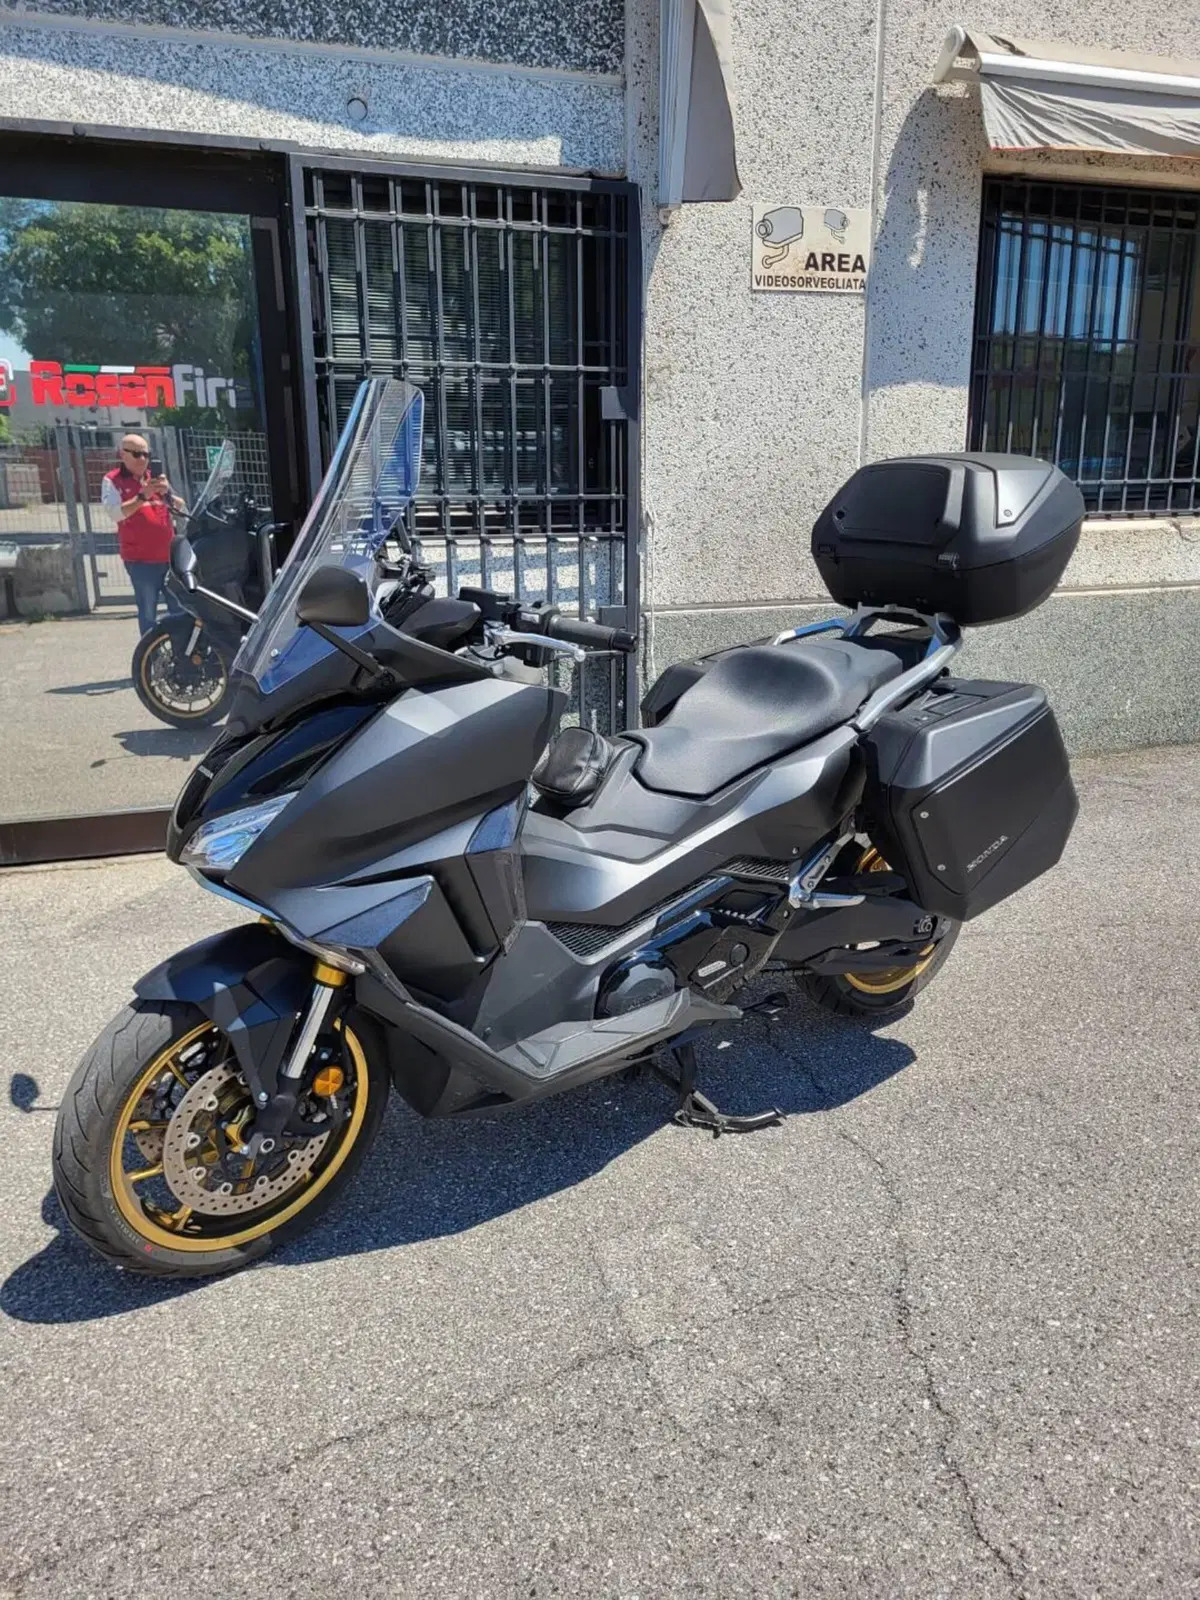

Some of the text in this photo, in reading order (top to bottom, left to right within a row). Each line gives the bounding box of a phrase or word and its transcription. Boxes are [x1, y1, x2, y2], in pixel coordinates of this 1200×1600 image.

[804, 252, 867, 273] AREA
[755, 275, 866, 290] VIDEOSORVEGLIATA
[966, 835, 1008, 873] HONDA
